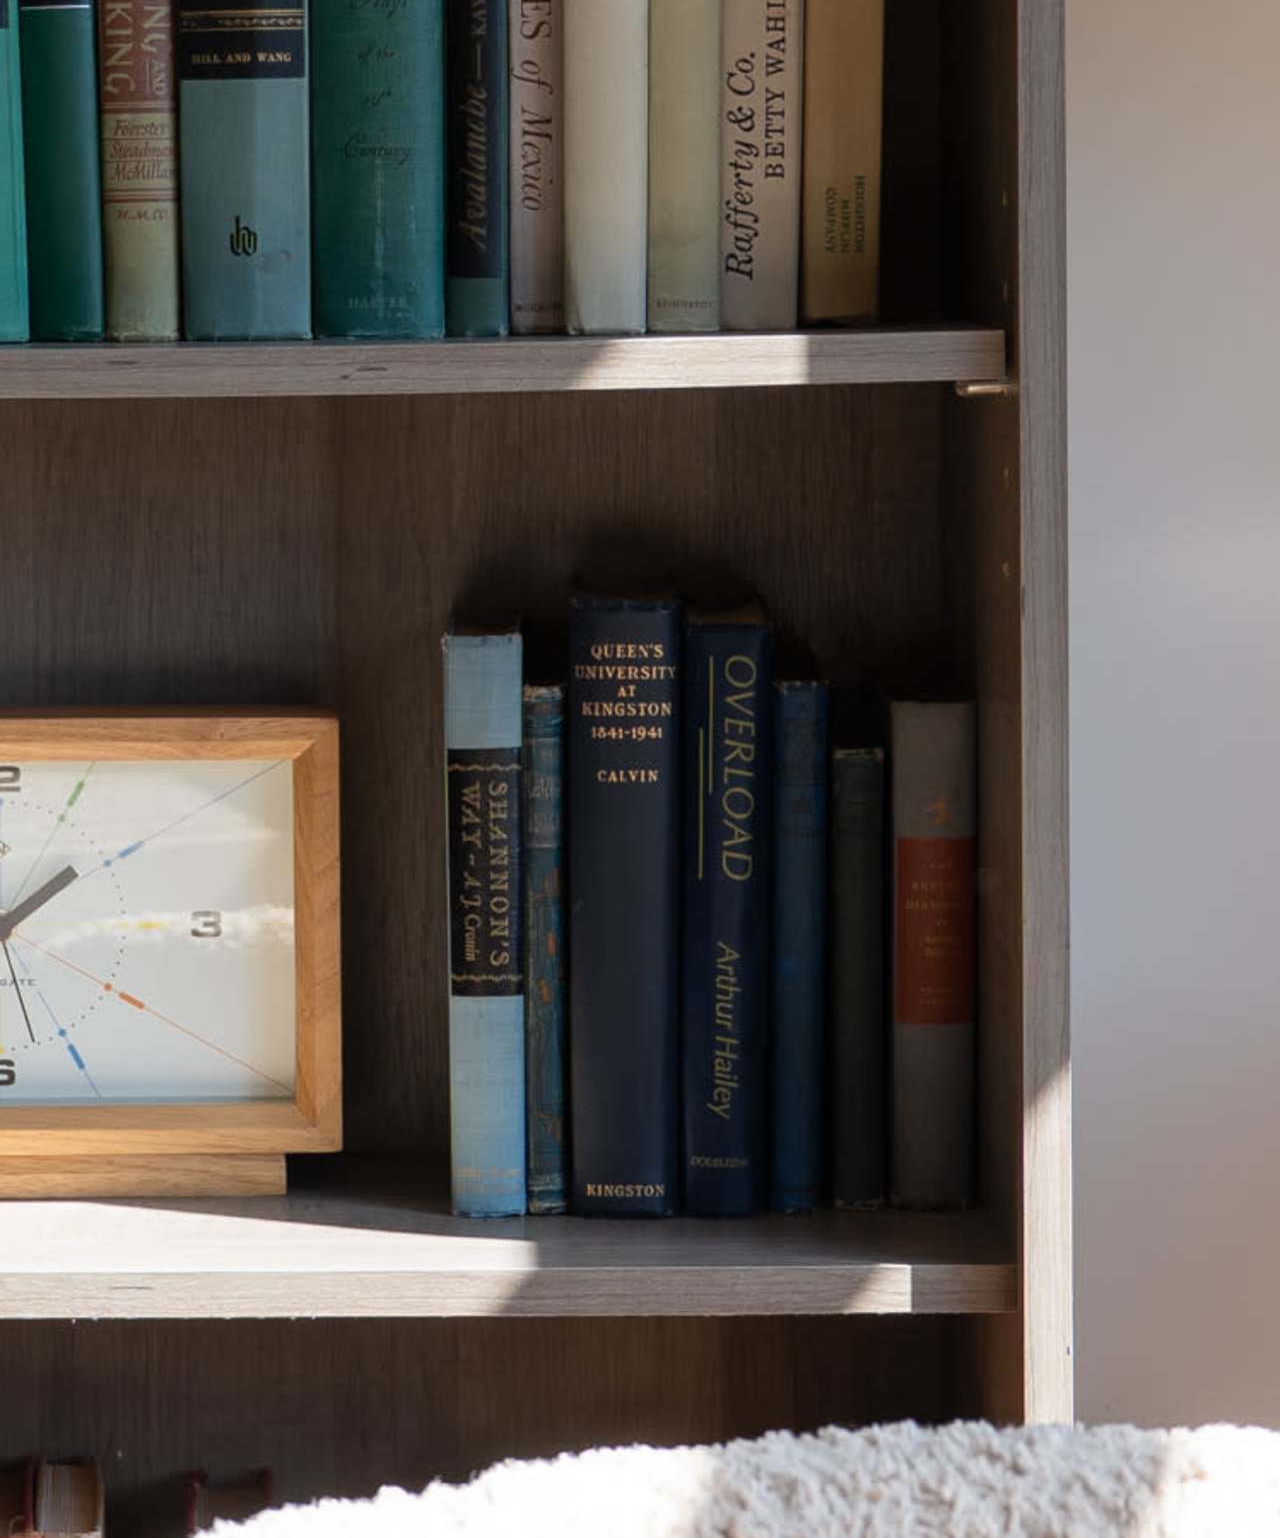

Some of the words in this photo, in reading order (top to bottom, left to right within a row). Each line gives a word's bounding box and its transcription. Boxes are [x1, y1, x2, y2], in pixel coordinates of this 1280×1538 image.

[192, 53, 221, 64] HILL
[226, 52, 251, 63] AND
[256, 51, 291, 62] WANG
[510, 60, 553, 94] of
[727, 52, 756, 96] Co.
[727, 106, 755, 132] &
[765, 89, 786, 179] BETTY
[521, 105, 553, 211] Mexico
[725, 138, 760, 280] Rafferty
[590, 642, 665, 660] QUEEN'S
[574, 665, 677, 680] UNIVERSITY
[616, 685, 636, 698] AT
[581, 702, 672, 717] KINGSTON
[591, 726, 663, 741] 1841-1941
[595, 769, 660, 784] CALVIN
[721, 654, 758, 882] OVERLOAD
[461, 781, 481, 846] WAY
[488, 779, 511, 968] SHANNON'S
[191, 910, 221, 939] 3
[714, 940, 743, 1033] Arthur
[706, 1035, 741, 1120] Hailey
[586, 1183, 666, 1198] KINGSTON
